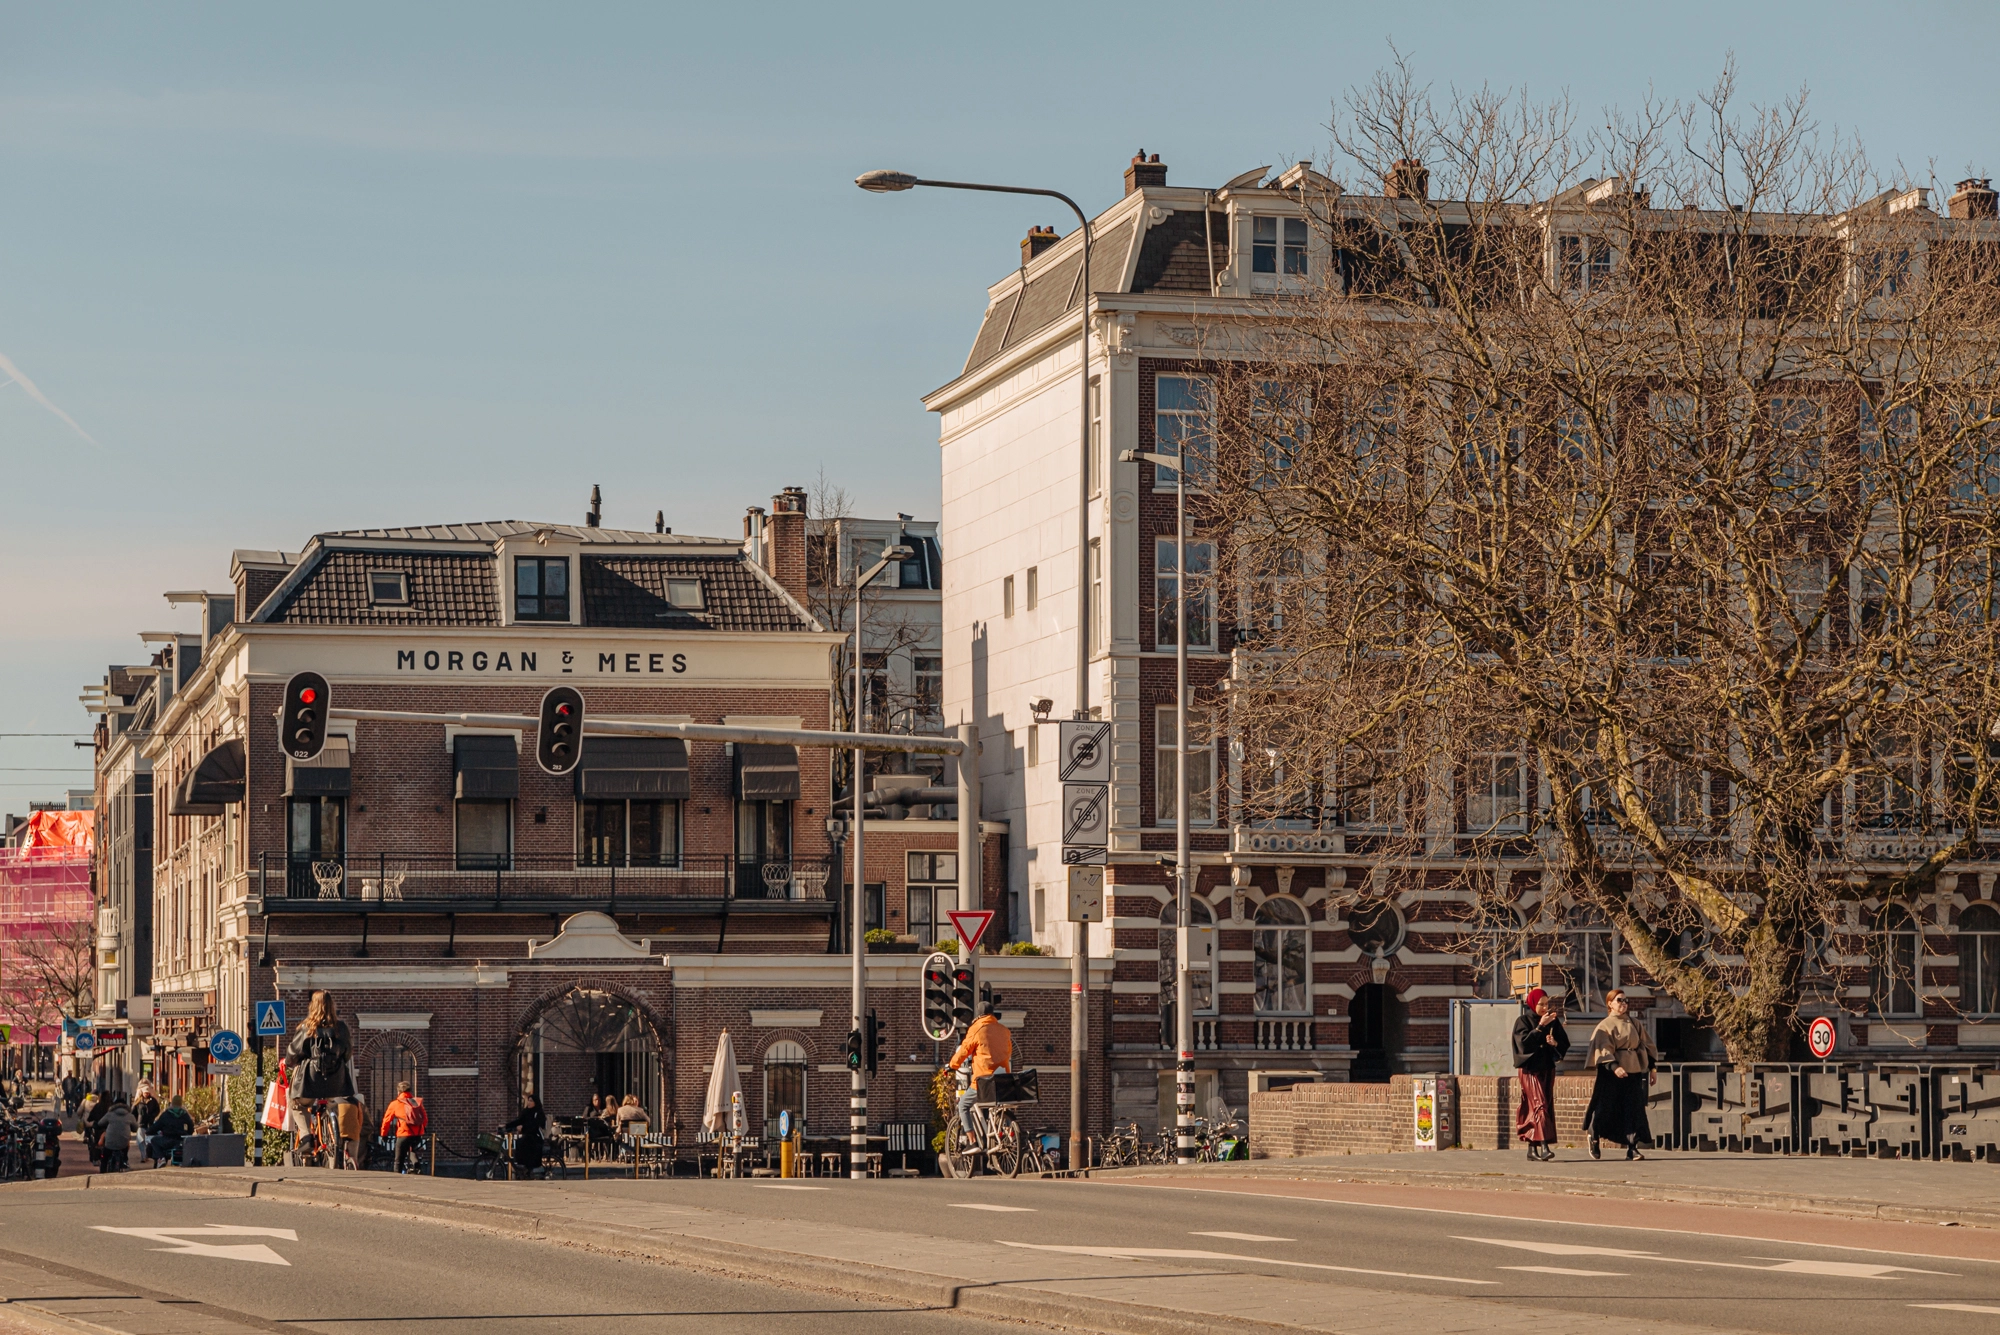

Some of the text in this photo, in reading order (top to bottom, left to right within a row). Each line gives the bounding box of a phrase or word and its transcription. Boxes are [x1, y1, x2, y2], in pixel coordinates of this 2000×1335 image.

[397, 650, 687, 673] MORGAN & MEES
[1075, 724, 1095, 732] ZONE
[294, 750, 309, 758] 022
[1076, 787, 1095, 795] ZONE
[1814, 1030, 1830, 1045] 30
